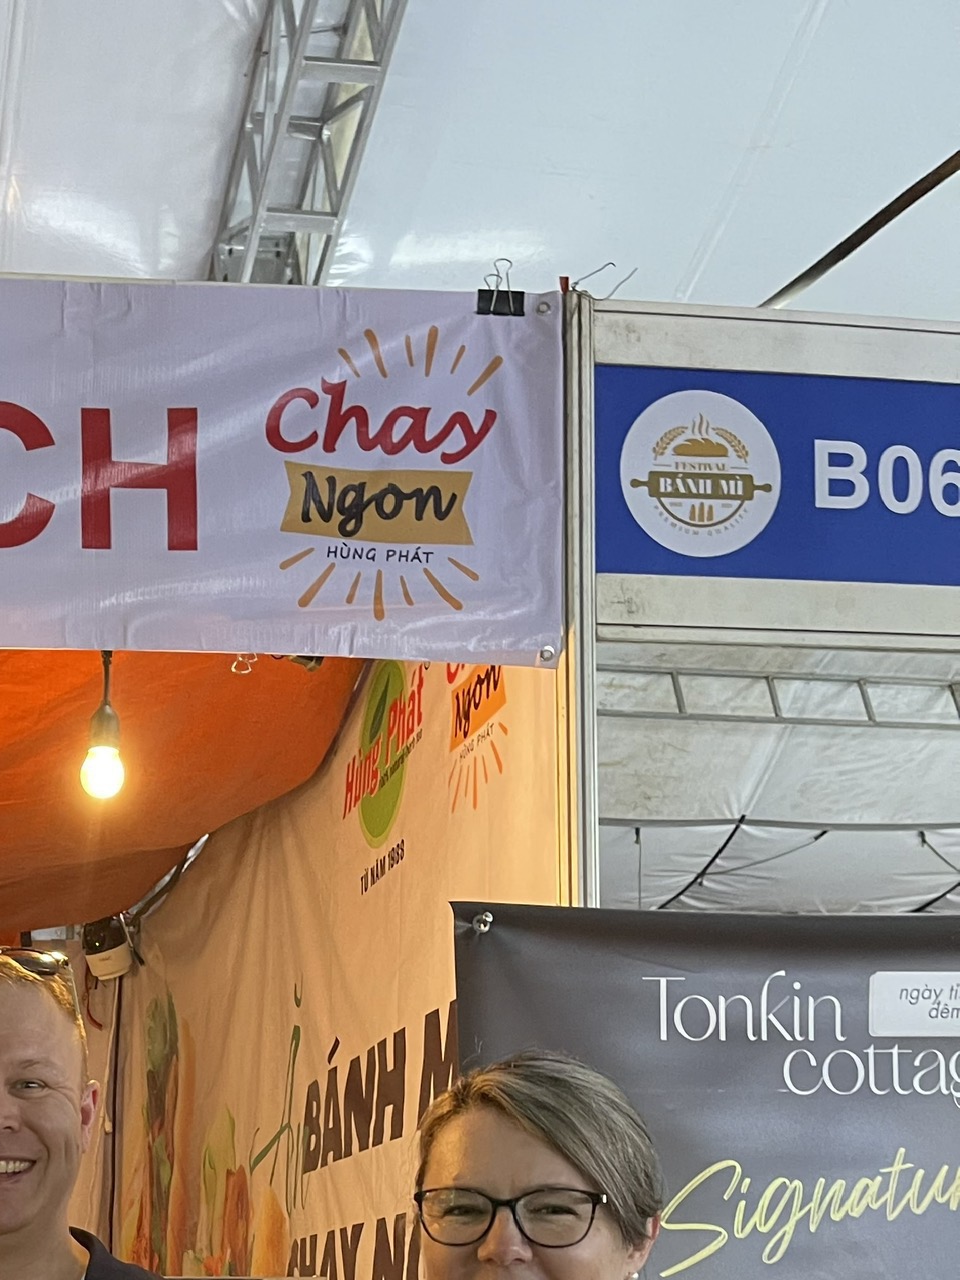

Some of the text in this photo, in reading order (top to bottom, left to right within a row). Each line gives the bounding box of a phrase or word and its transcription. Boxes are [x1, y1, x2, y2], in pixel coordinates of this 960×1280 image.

[265, 376, 497, 465] Chay
[300, 471, 457, 537] Ngon
[659, 473, 744, 496] BÁNH MÌ
[814, 439, 960, 518] B06
[326, 542, 434, 564] HÙNG PHÁT
[454, 664, 502, 739] Ngon
[642, 970, 847, 1042] Tonkin
[899, 983, 944, 1006] ngày
[303, 1036, 406, 1175] BÁNH
